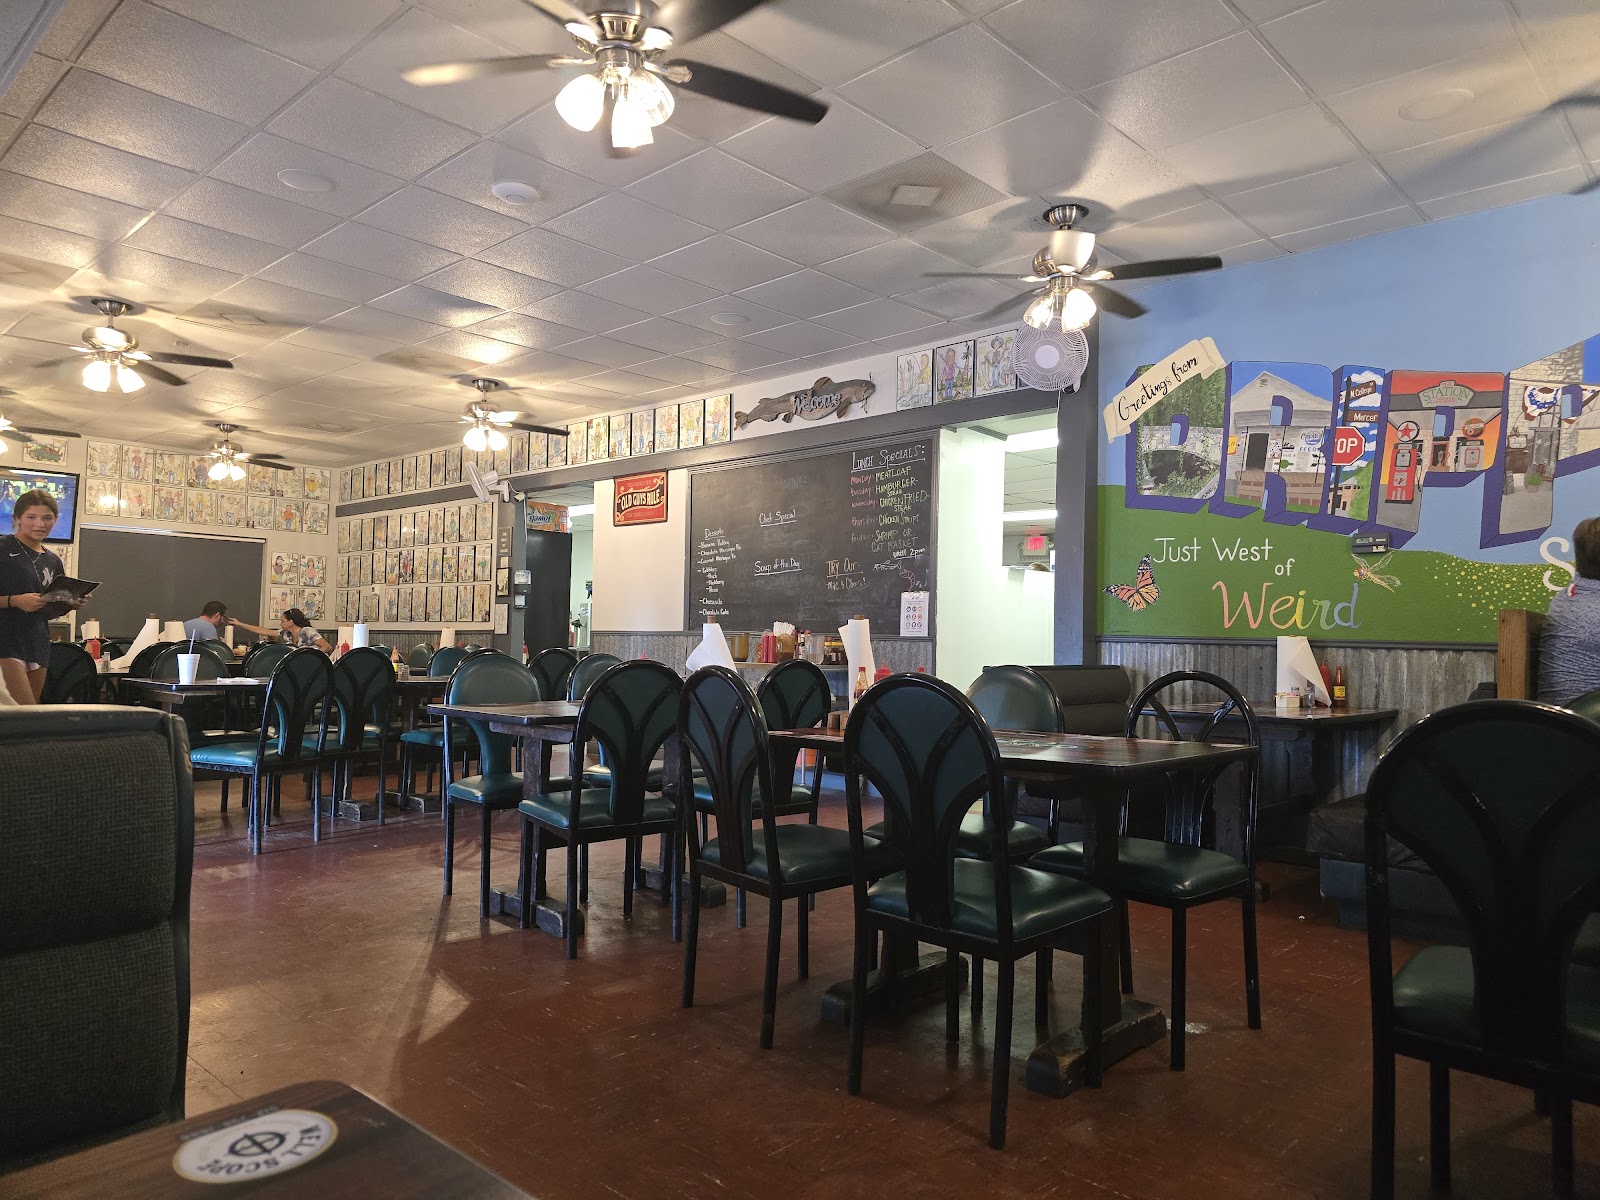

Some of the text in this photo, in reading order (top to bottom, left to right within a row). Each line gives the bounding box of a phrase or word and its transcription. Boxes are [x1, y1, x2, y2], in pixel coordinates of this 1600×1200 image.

[1118, 356, 1198, 421] Greetings from
[1422, 386, 1470, 402] STATION
[792, 393, 841, 413] Welcome
[1353, 413, 1378, 421] Mercer
[875, 466, 911, 482] MEATLOAF
[621, 489, 660, 510] OLD GUYS RULE
[529, 514, 551, 523] Towels
[759, 509, 796, 524] Chef Special
[887, 537, 918, 551] BASKET
[1153, 537, 1273, 563] Just West
[754, 560, 772, 575] Soup
[773, 558, 779, 570] of
[790, 557, 800, 570] Day
[1275, 558, 1295, 576] of
[1212, 581, 1364, 629] Weird
[281, 1125, 321, 1157] WELL
